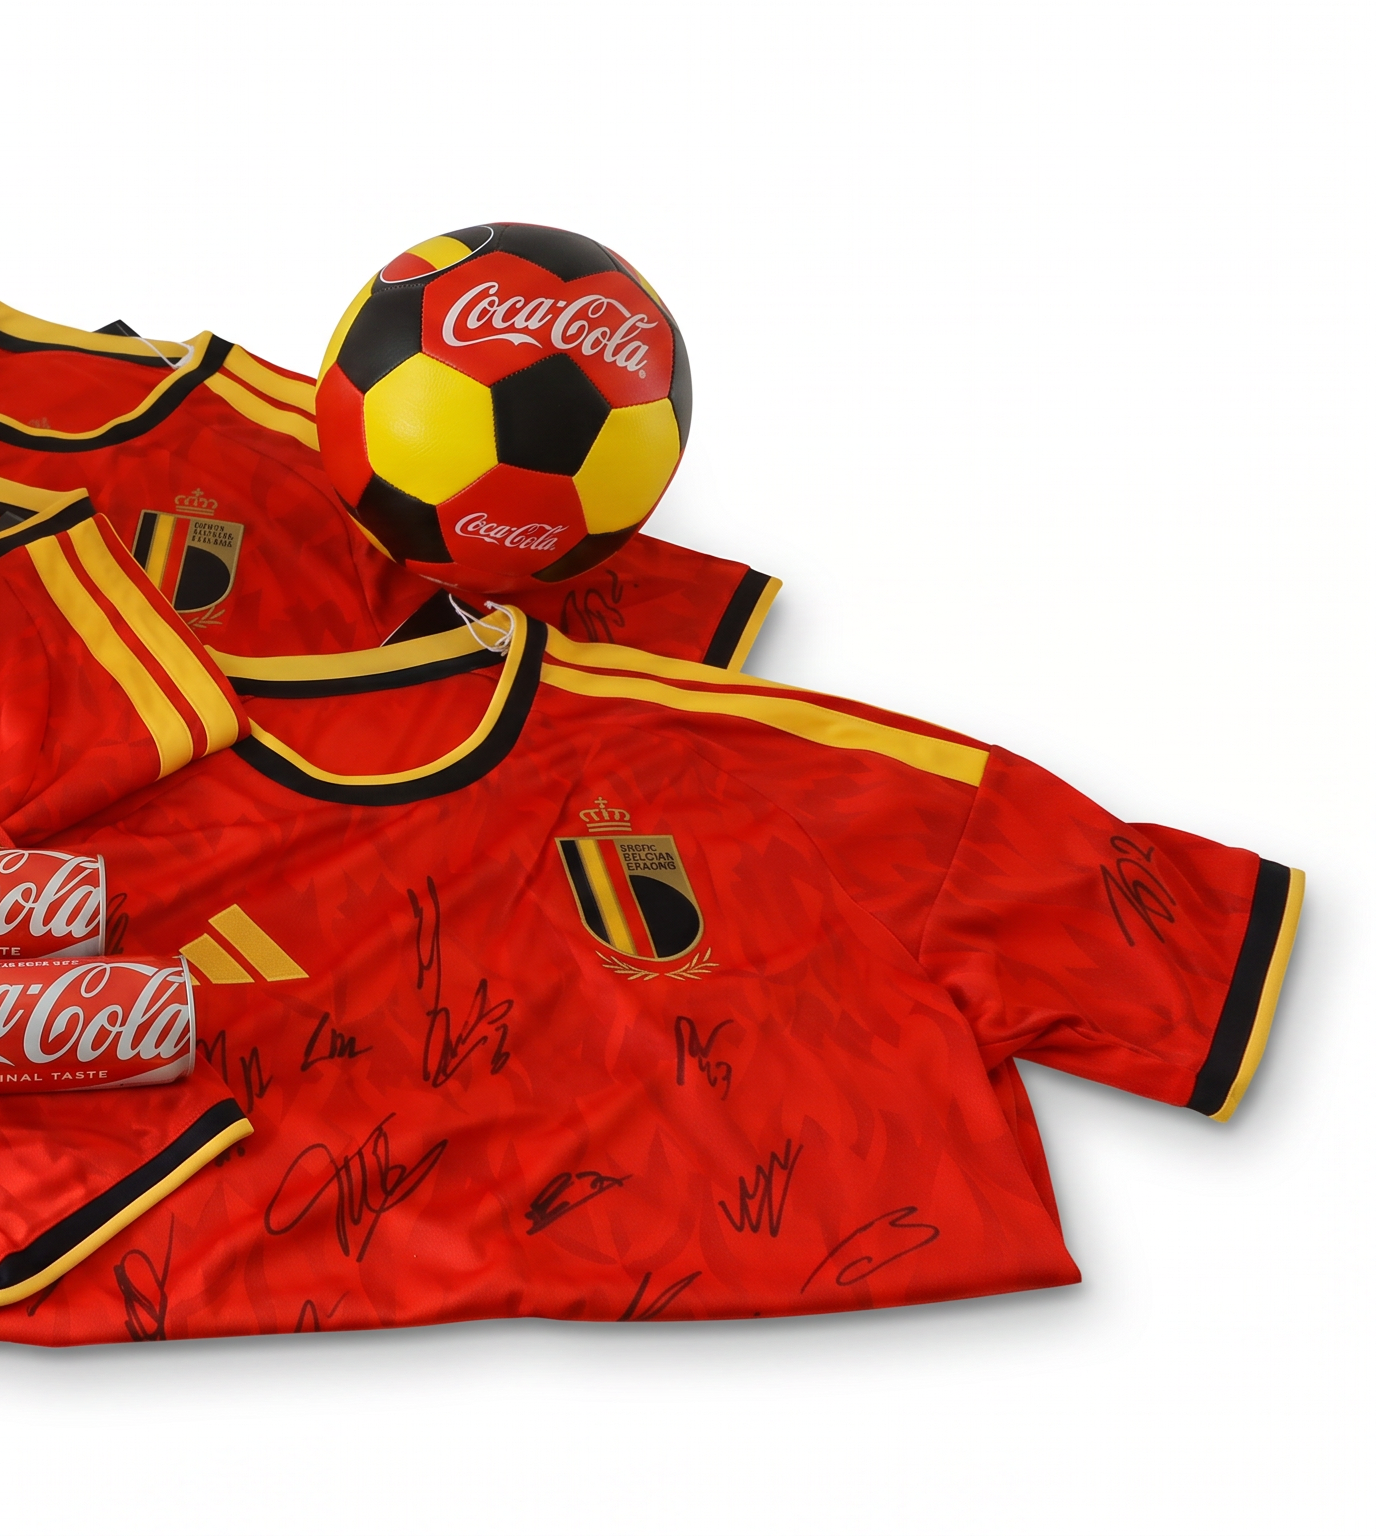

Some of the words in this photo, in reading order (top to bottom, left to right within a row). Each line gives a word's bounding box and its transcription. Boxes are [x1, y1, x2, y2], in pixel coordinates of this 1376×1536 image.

[442, 281, 658, 374] Coca-Cola
[454, 512, 569, 552] Coca-Cola
[50, 1069, 109, 1081] TASTE
